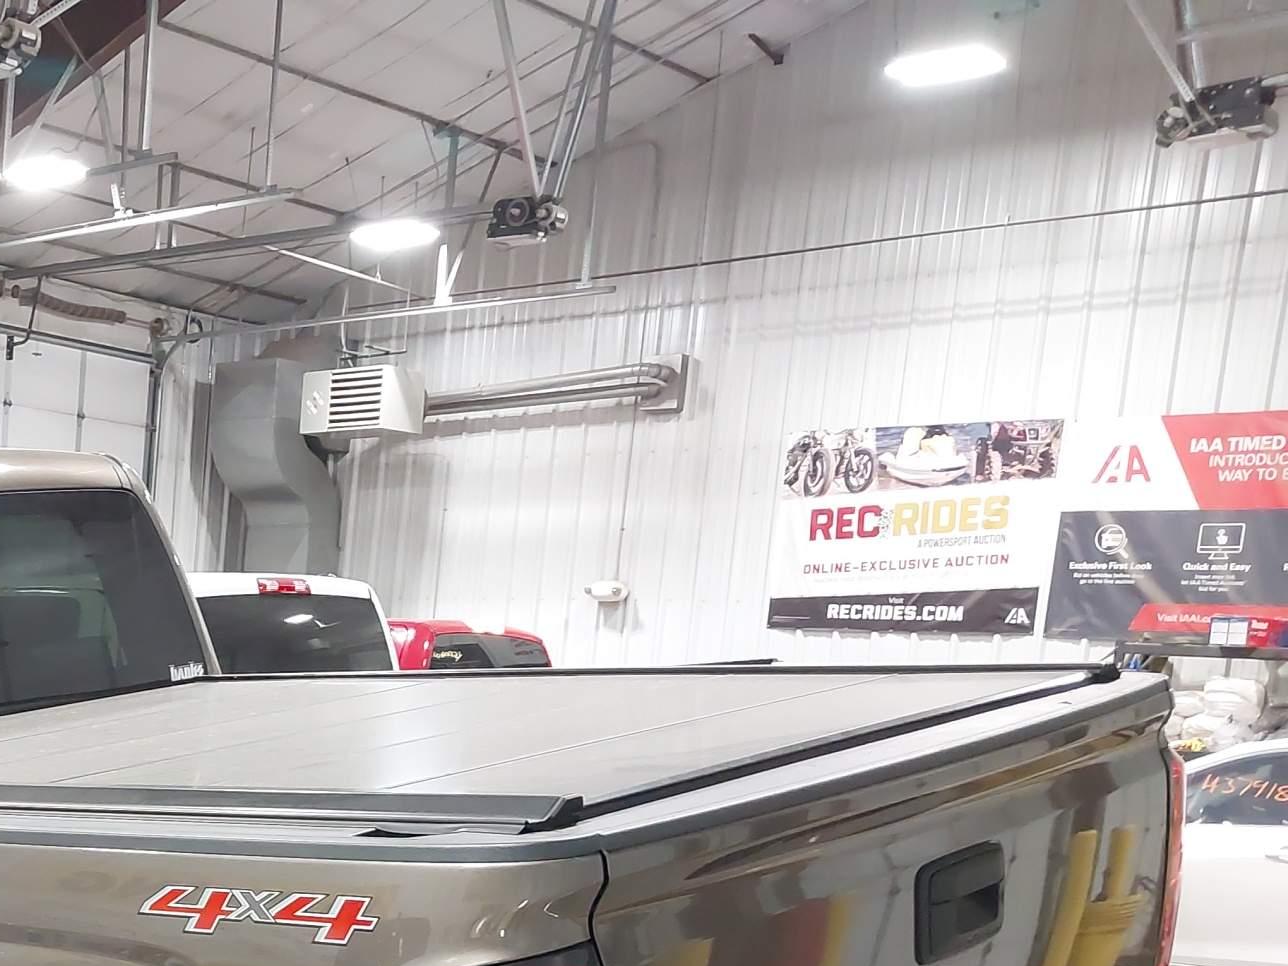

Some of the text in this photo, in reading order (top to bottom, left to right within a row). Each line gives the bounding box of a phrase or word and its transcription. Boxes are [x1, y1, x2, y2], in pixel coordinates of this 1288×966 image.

[1190, 435, 1287, 453] IAA TIMED
[1218, 468, 1253, 482] WAY
[1256, 467, 1278, 480] TO
[809, 495, 1010, 541] REC RIDES
[973, 534, 1006, 545] AUCTION
[803, 553, 1010, 575] ONLINE-EXCLUSIVE AUCTION
[1182, 562, 1252, 573] Quick and Easy
[826, 603, 965, 622] RECRIDES.COM
[1157, 612, 1178, 623] Visit
